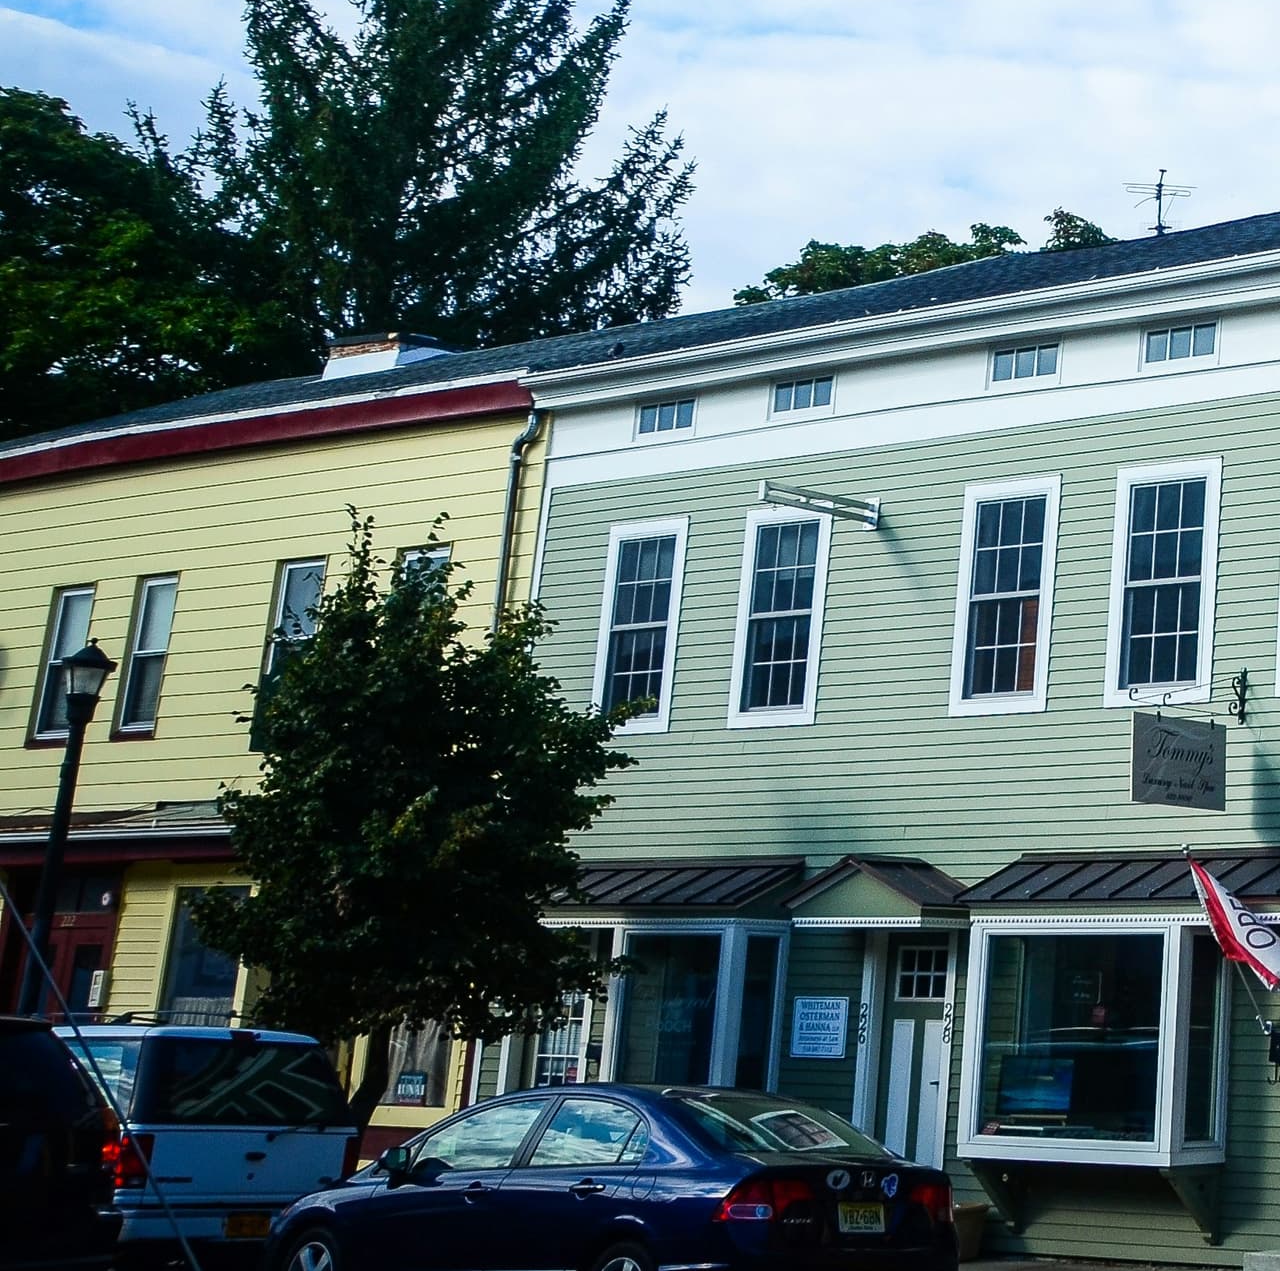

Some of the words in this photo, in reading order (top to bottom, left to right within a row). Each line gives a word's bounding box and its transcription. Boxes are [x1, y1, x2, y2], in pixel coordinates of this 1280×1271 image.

[1147, 728, 1214, 779] Tommy's
[799, 1011, 840, 1021] OSTERMAN
[801, 1001, 841, 1010] WHITEMAN
[858, 1002, 869, 1045] 226
[942, 1002, 954, 1045] 228
